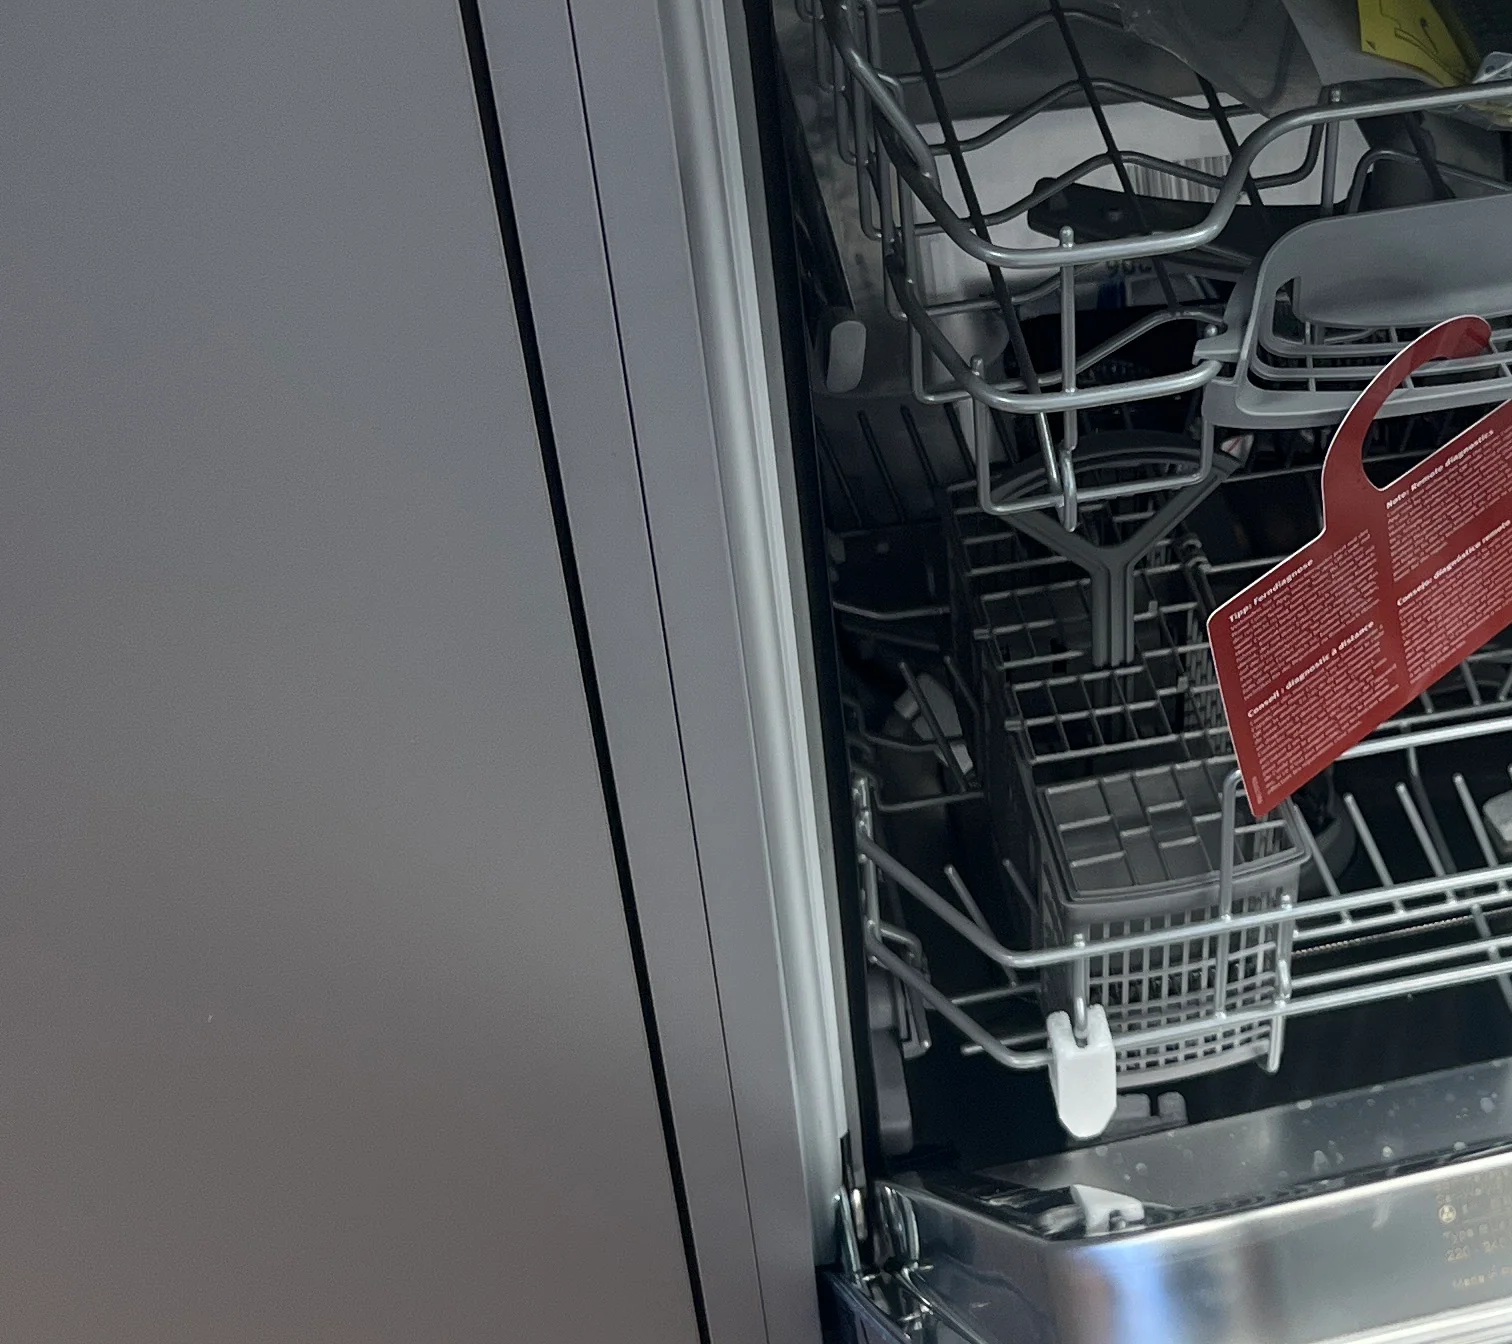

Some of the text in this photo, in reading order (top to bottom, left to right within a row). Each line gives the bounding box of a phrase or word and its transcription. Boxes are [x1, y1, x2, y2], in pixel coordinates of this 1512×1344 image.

[1411, 464, 1444, 492] Remote
[1444, 429, 1494, 468] diagnostics
[1253, 558, 1314, 605] Ferndiagnose
[1285, 653, 1330, 690] diagnostic
